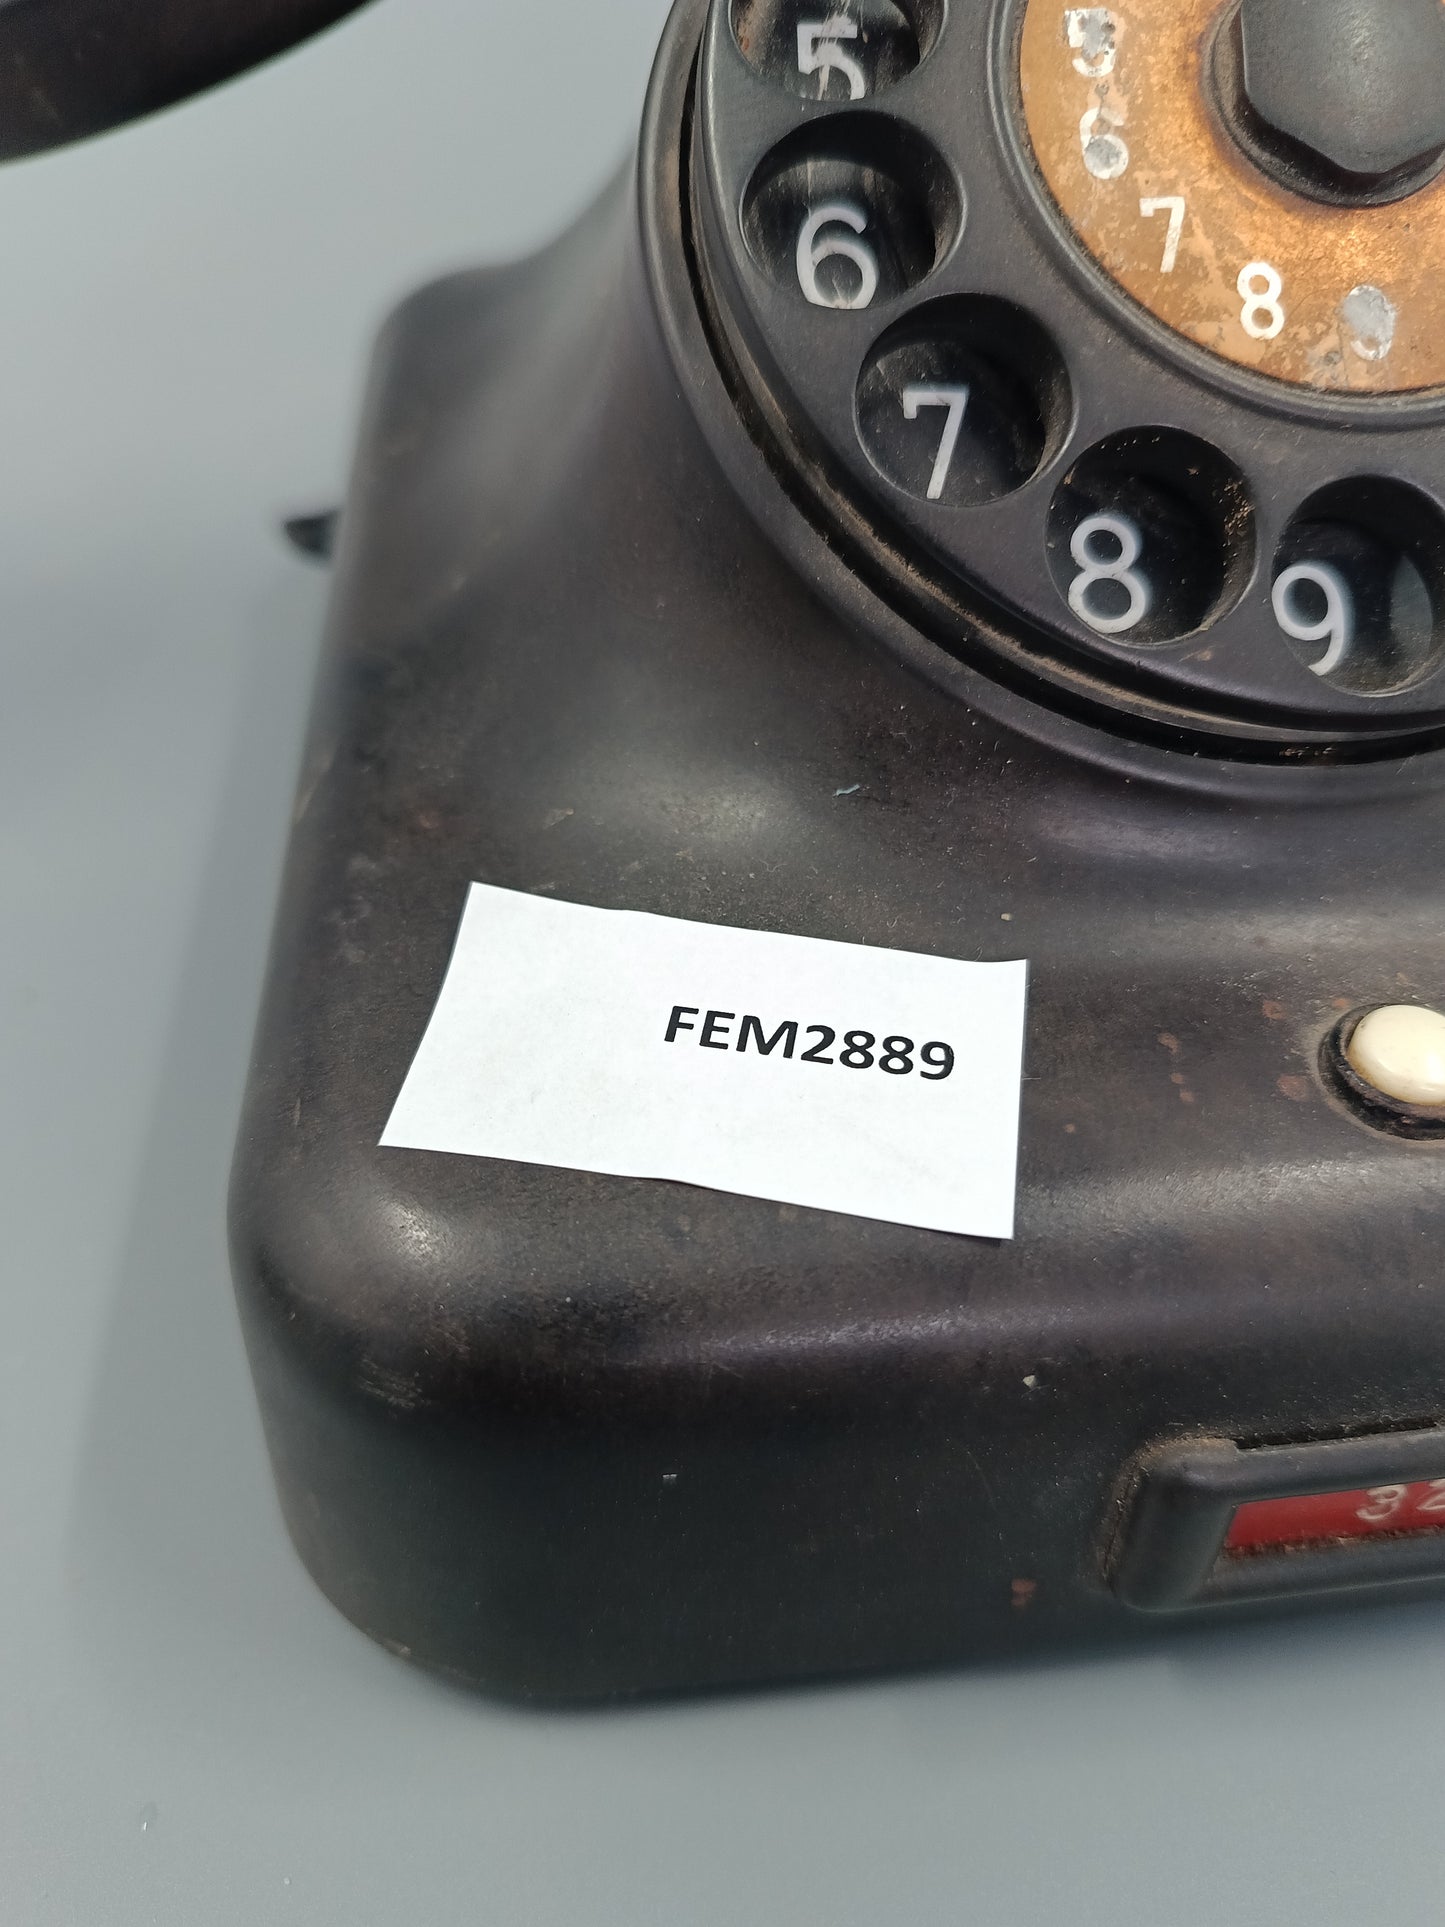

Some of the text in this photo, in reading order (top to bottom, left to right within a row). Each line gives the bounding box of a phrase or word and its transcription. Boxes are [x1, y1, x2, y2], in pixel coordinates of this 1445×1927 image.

[797, 19, 866, 101] 5
[1079, 107, 1129, 180] 6
[796, 207, 878, 310] 6
[1139, 196, 1185, 273] 7
[1237, 261, 1286, 341] 8
[903, 385, 970, 499] 7
[1068, 514, 1148, 633] 8
[1271, 562, 1349, 677] 9
[663, 1005, 955, 1081] FEM2889
